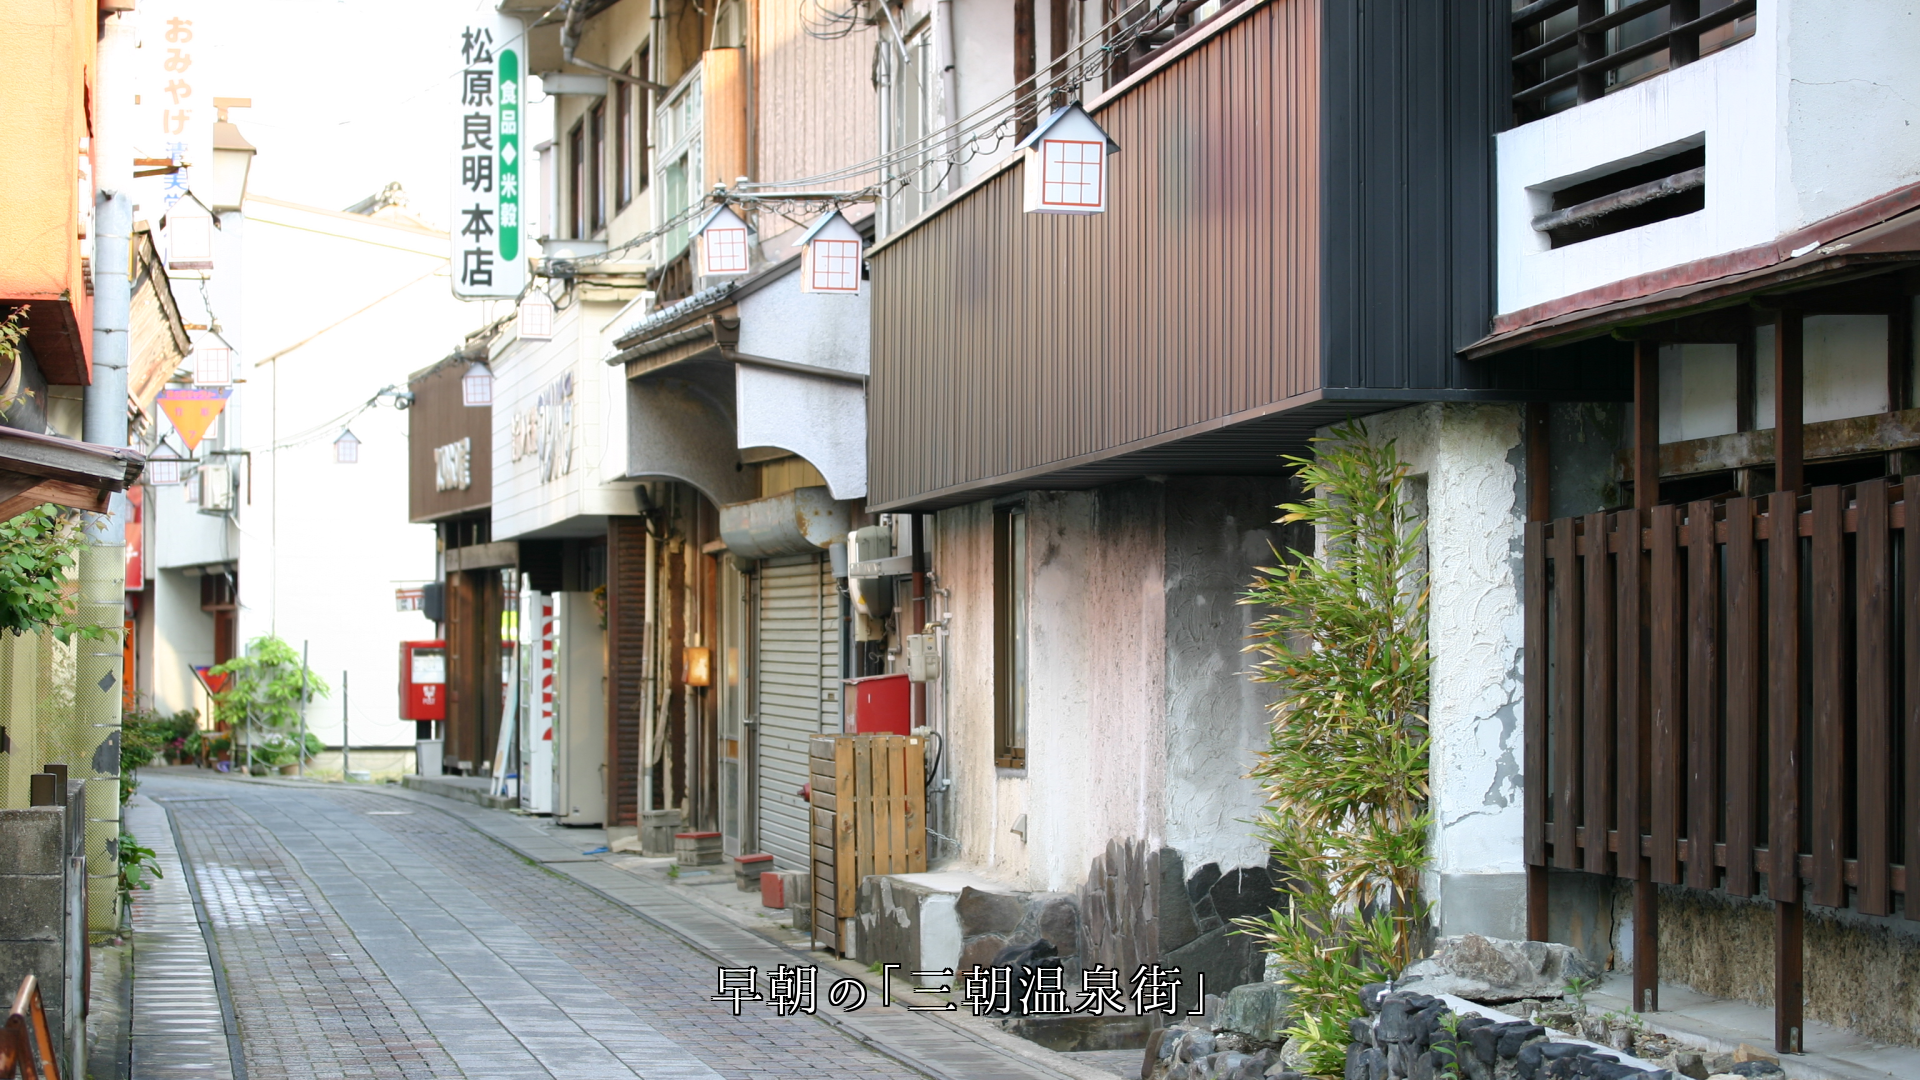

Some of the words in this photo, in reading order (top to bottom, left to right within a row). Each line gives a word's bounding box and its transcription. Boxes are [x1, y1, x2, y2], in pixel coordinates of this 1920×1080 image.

[163, 16, 193, 135] おみやげ
[461, 26, 493, 287] 松原良明本店
